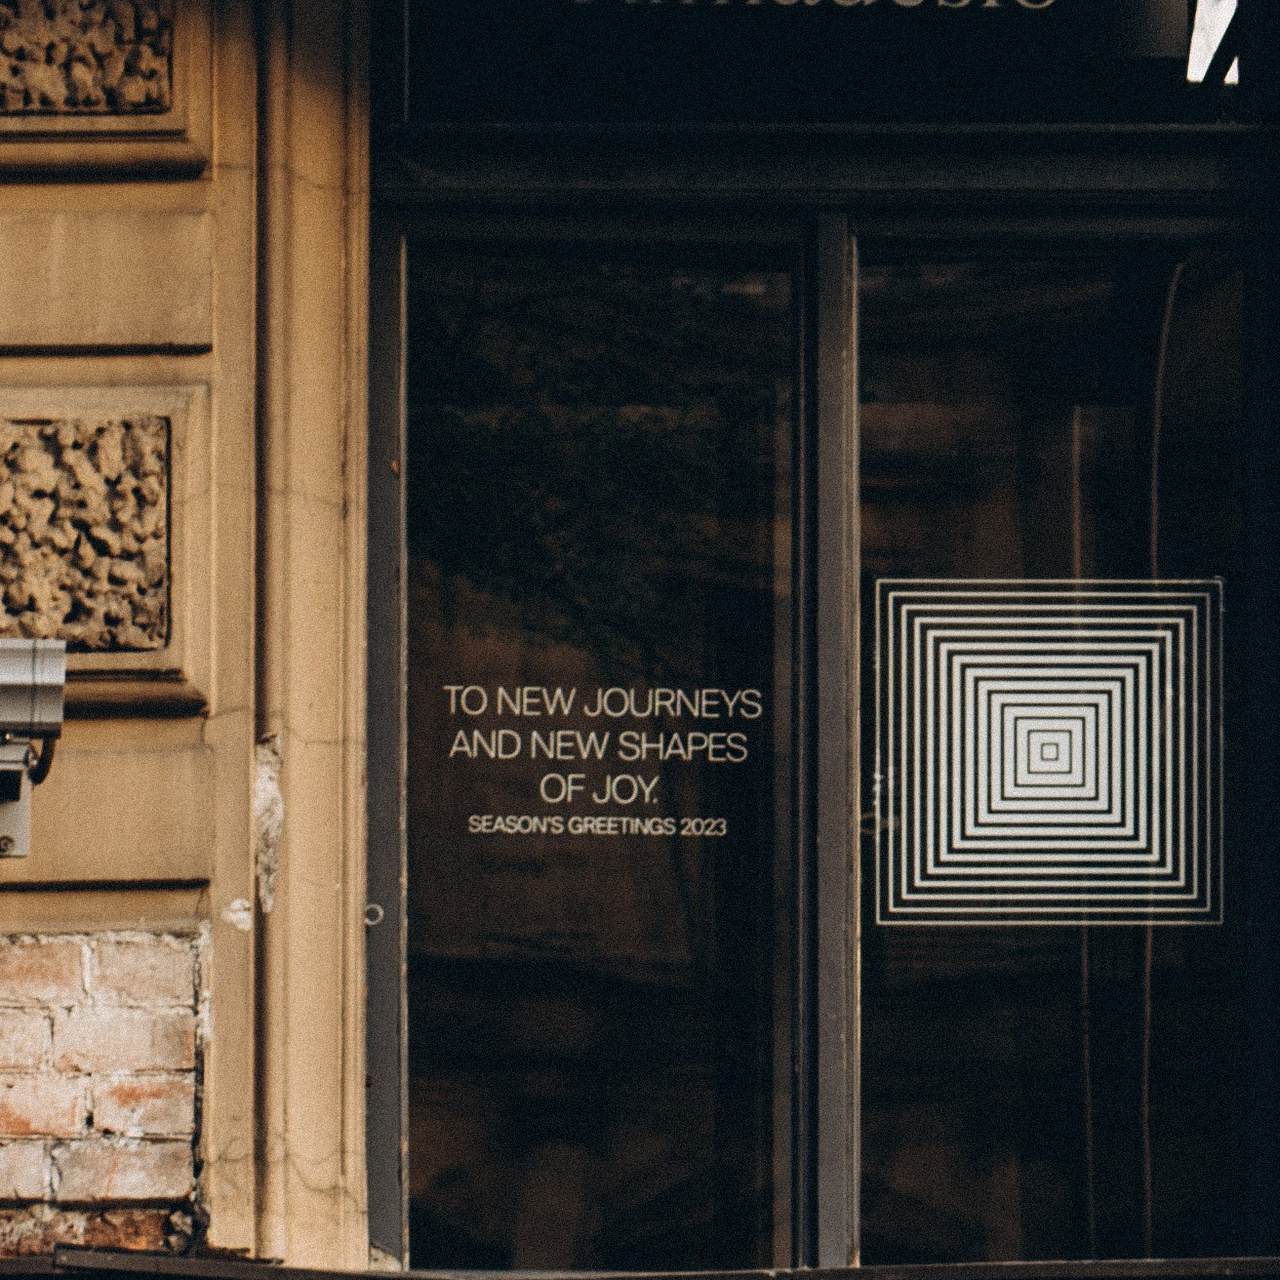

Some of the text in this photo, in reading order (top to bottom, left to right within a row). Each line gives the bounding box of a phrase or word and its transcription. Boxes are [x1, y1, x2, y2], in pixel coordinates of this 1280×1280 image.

[442, 685, 763, 719] TO NEW JOURNEYS
[448, 729, 749, 763] AND NEW SHAPES
[540, 773, 660, 805] OF JOY.
[468, 815, 728, 838] SEASON'S GREETINGS 2023
